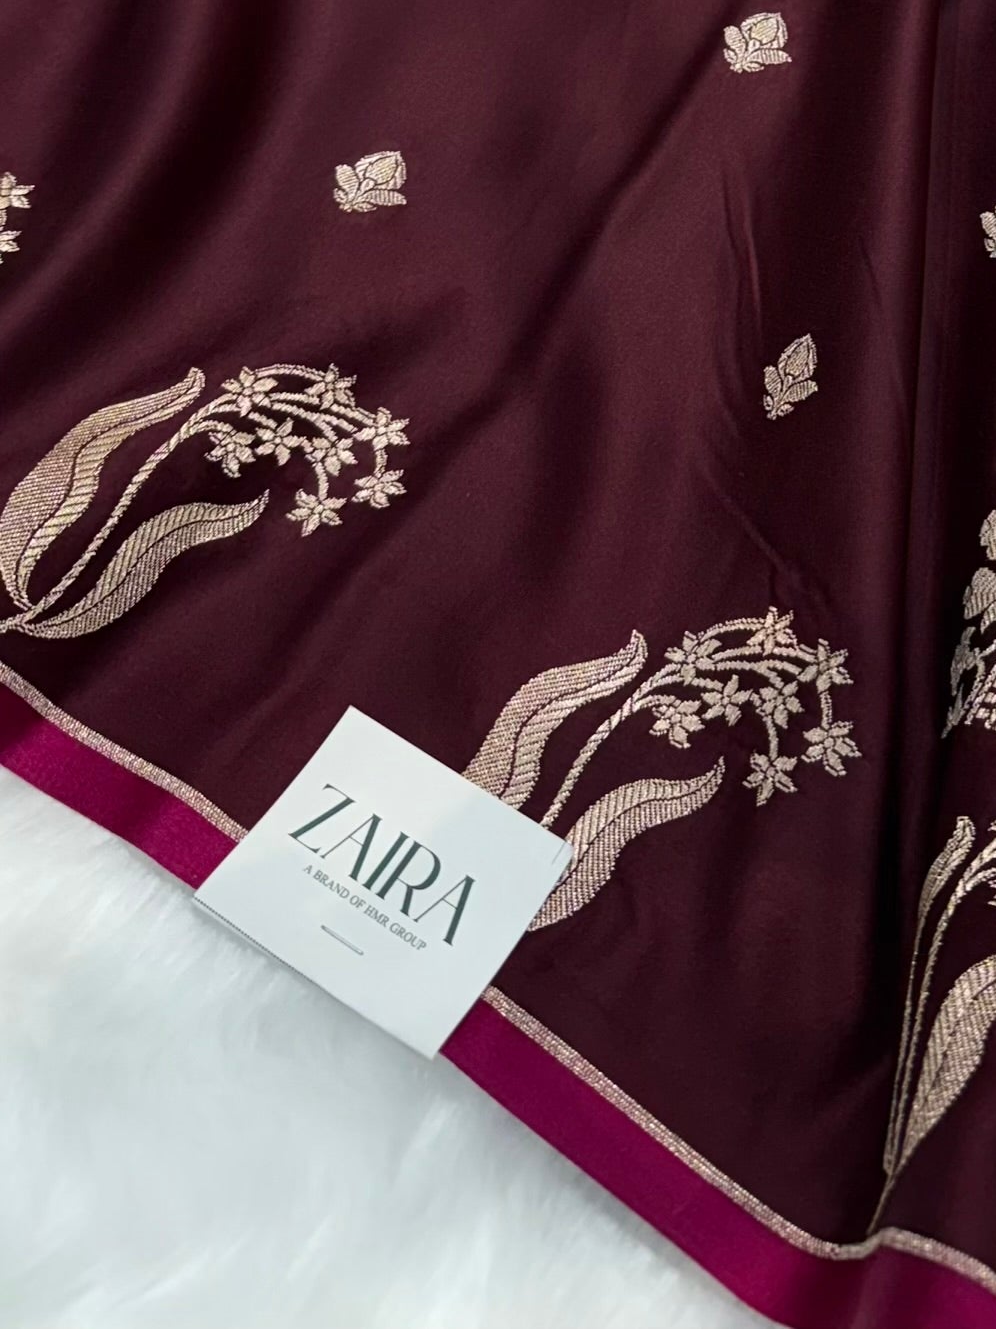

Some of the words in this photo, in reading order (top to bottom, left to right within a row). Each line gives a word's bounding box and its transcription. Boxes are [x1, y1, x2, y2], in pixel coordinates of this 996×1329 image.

[288, 783, 476, 946] ZAIRA
[303, 864, 313, 875] A
[313, 869, 350, 899] BRAND
[349, 895, 367, 909] OF
[363, 905, 390, 928] HMR
[389, 922, 427, 950] GROUP
